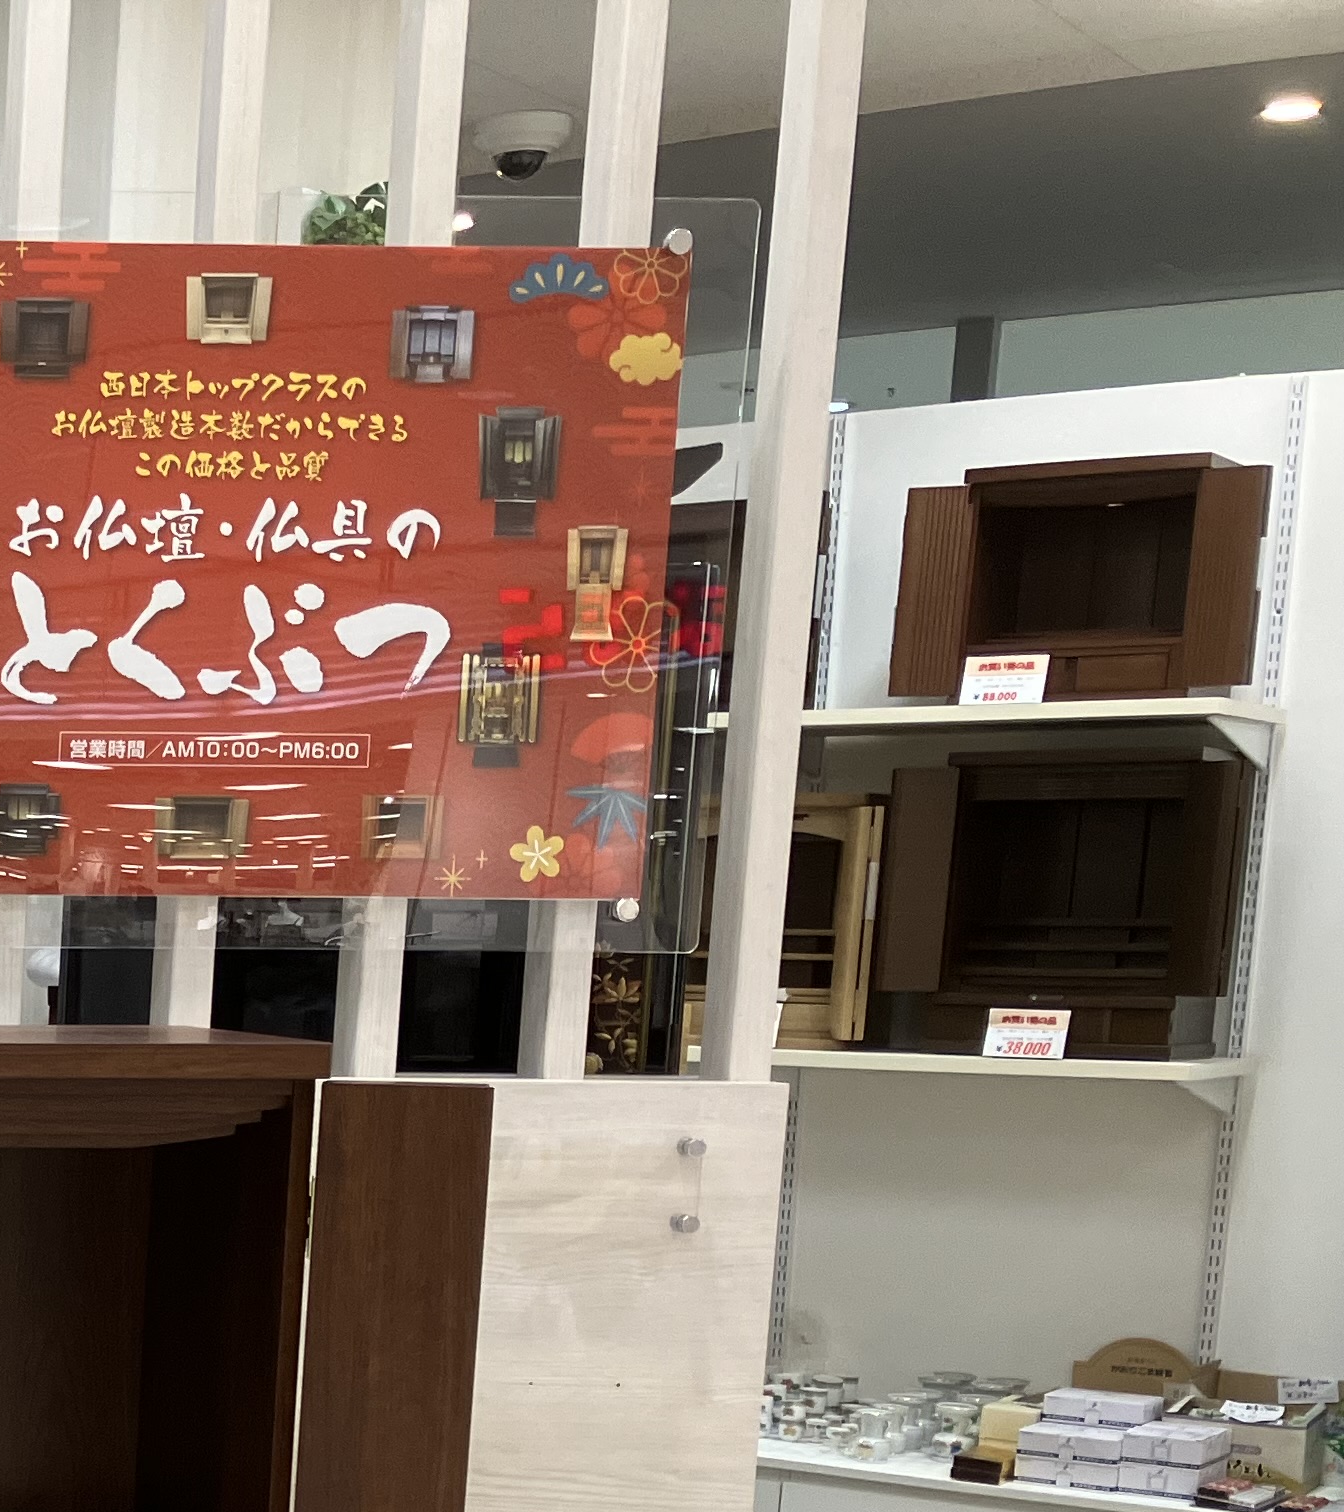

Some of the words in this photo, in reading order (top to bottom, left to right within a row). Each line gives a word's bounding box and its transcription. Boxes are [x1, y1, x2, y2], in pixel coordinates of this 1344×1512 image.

[100, 370, 367, 401] 西日本トップクラスの
[51, 407, 409, 443] お仏壇製造本数だからできる
[134, 450, 329, 481] この価格と品質
[9, 492, 441, 563] お仏壇・仏具の
[0, 570, 452, 705] とくぶつ
